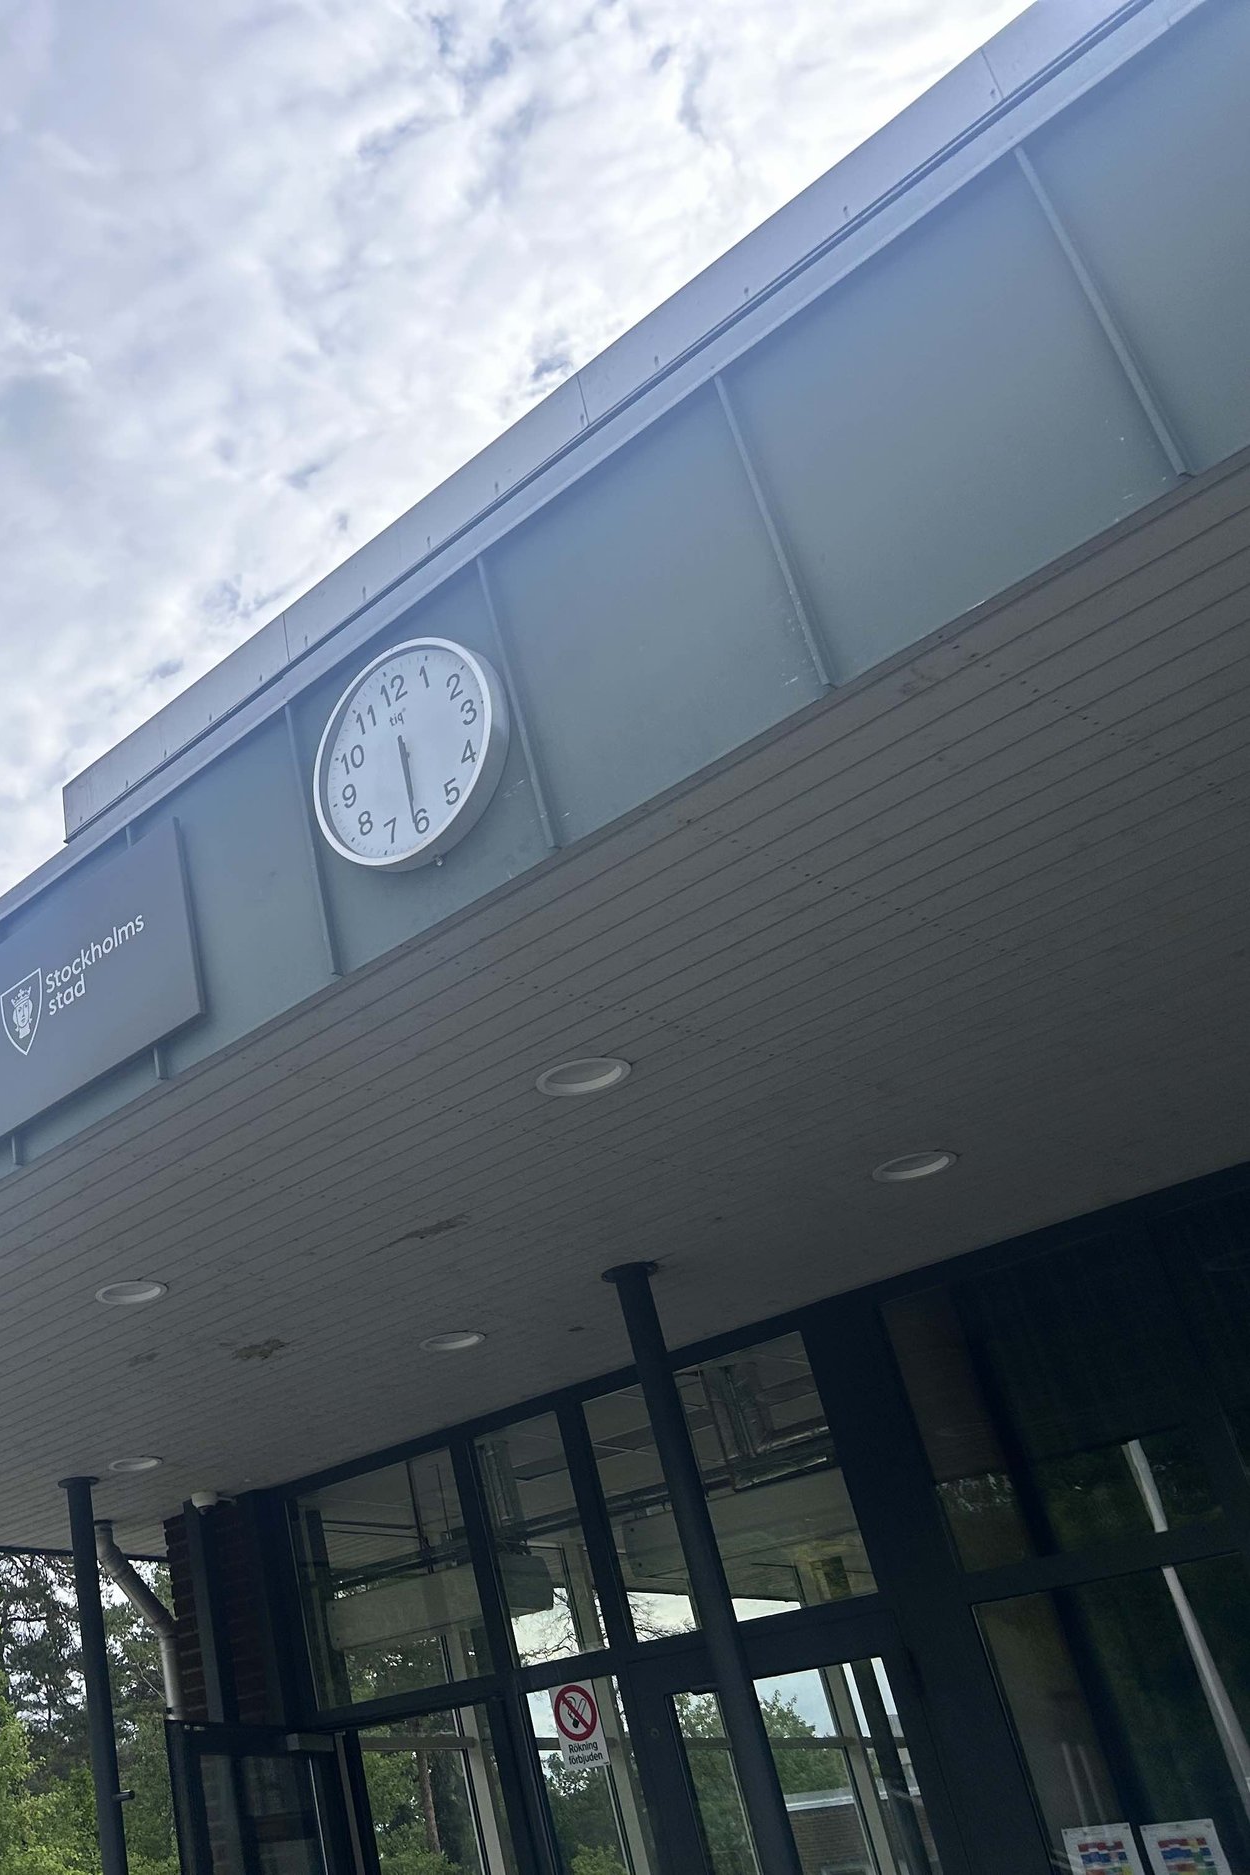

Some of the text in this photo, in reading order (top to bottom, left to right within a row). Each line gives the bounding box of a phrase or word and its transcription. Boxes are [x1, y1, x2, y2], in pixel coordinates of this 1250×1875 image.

[419, 666, 430, 688] 1
[446, 673, 464, 701] 2
[380, 674, 408, 707] 12
[356, 705, 377, 735] 11
[460, 699, 477, 725] 3
[341, 745, 365, 775] 10
[461, 739, 477, 764] 4
[342, 784, 357, 808] 9
[443, 778, 460, 805] 5
[358, 811, 373, 836] 8
[383, 817, 397, 844] 7
[414, 808, 430, 834] 6
[45, 914, 145, 993] Stockholms
[48, 974, 86, 1015] stad
[568, 1741, 598, 1753] Rökning
[569, 1752, 603, 1765] förbjuden
